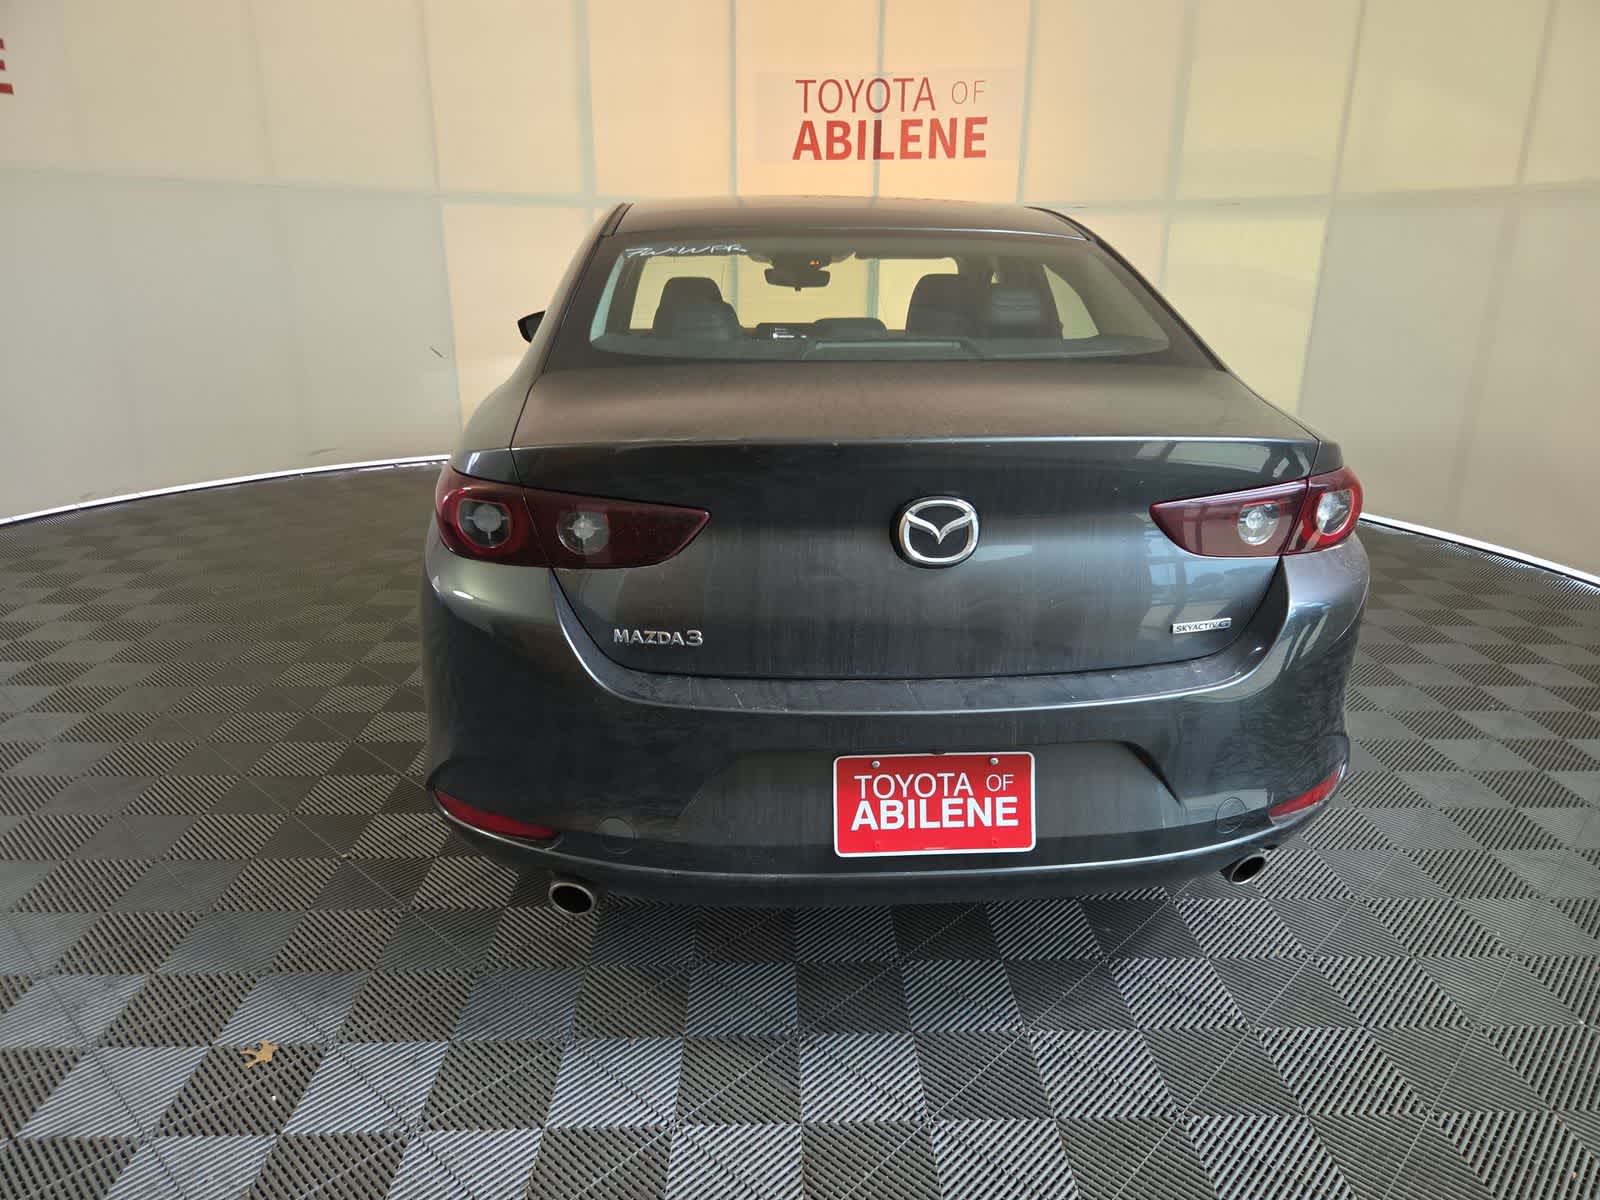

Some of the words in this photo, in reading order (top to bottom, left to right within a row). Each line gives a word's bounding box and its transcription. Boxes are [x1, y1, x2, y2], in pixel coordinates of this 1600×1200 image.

[795, 77, 936, 114] TOYOTA
[951, 80, 985, 105] OF
[792, 117, 988, 161] ABILENE
[854, 772, 974, 800] TOYOTA
[985, 774, 1015, 792] OF
[851, 796, 1019, 831] ABILENE
